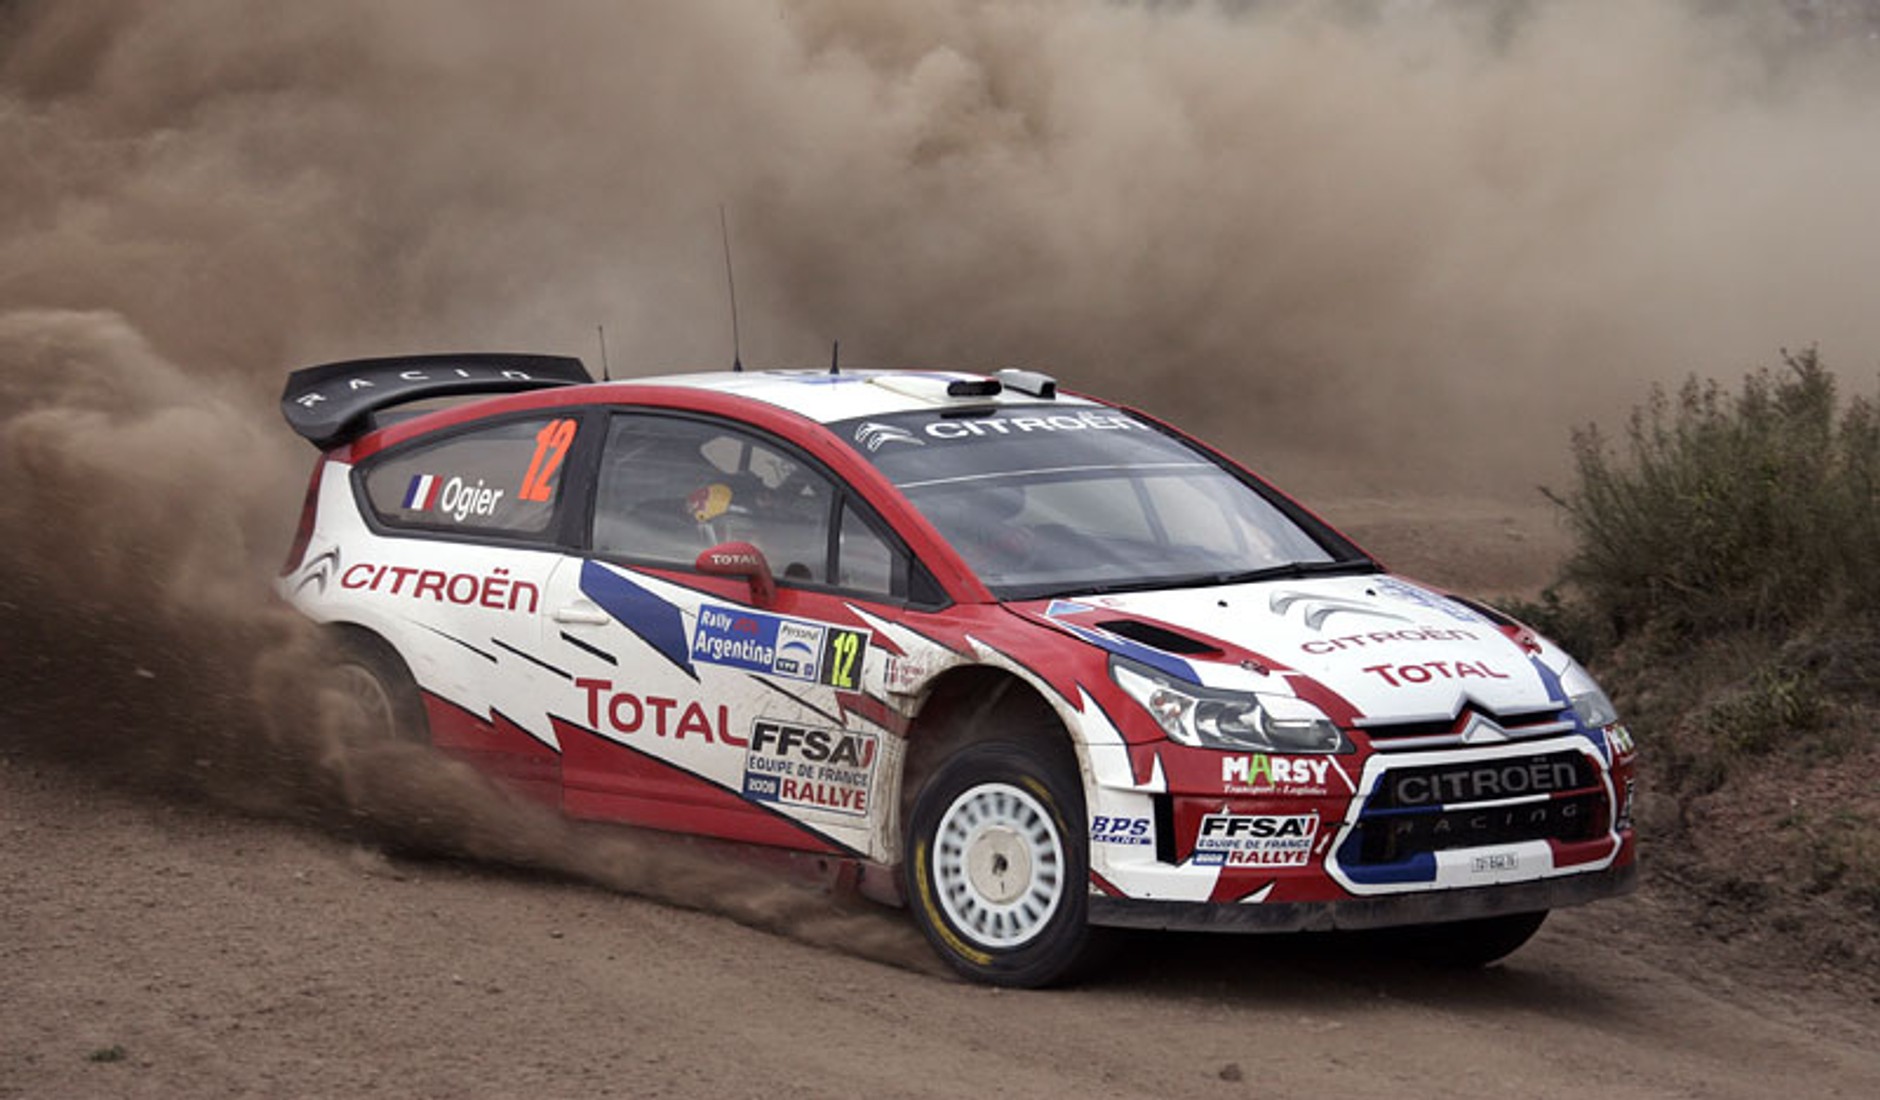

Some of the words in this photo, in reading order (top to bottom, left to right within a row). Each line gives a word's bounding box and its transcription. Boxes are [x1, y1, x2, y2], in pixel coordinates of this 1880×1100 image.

[518, 418, 577, 502] 12
[441, 476, 504, 522] Ogier
[710, 554, 759, 565] TOTAL
[701, 610, 733, 634] Rally
[694, 630, 774, 665] Argentina
[831, 631, 859, 687] 12
[1362, 660, 1510, 688] TOTAL
[575, 677, 749, 748] TOTAL
[752, 722, 859, 768] FFSA
[749, 756, 794, 775] EQUIPE
[797, 763, 814, 779] DE
[818, 766, 869, 788] FRANCE
[1222, 753, 1329, 784] MARSY
[781, 778, 866, 811] RALLYE
[1090, 815, 1151, 836] BPS
[1201, 817, 1303, 837] FFSA
[1198, 838, 1238, 849] EQUIPE
[1245, 838, 1262, 849] DE
[1264, 838, 1310, 849] FRANCE
[1229, 850, 1308, 864] RALLYE
